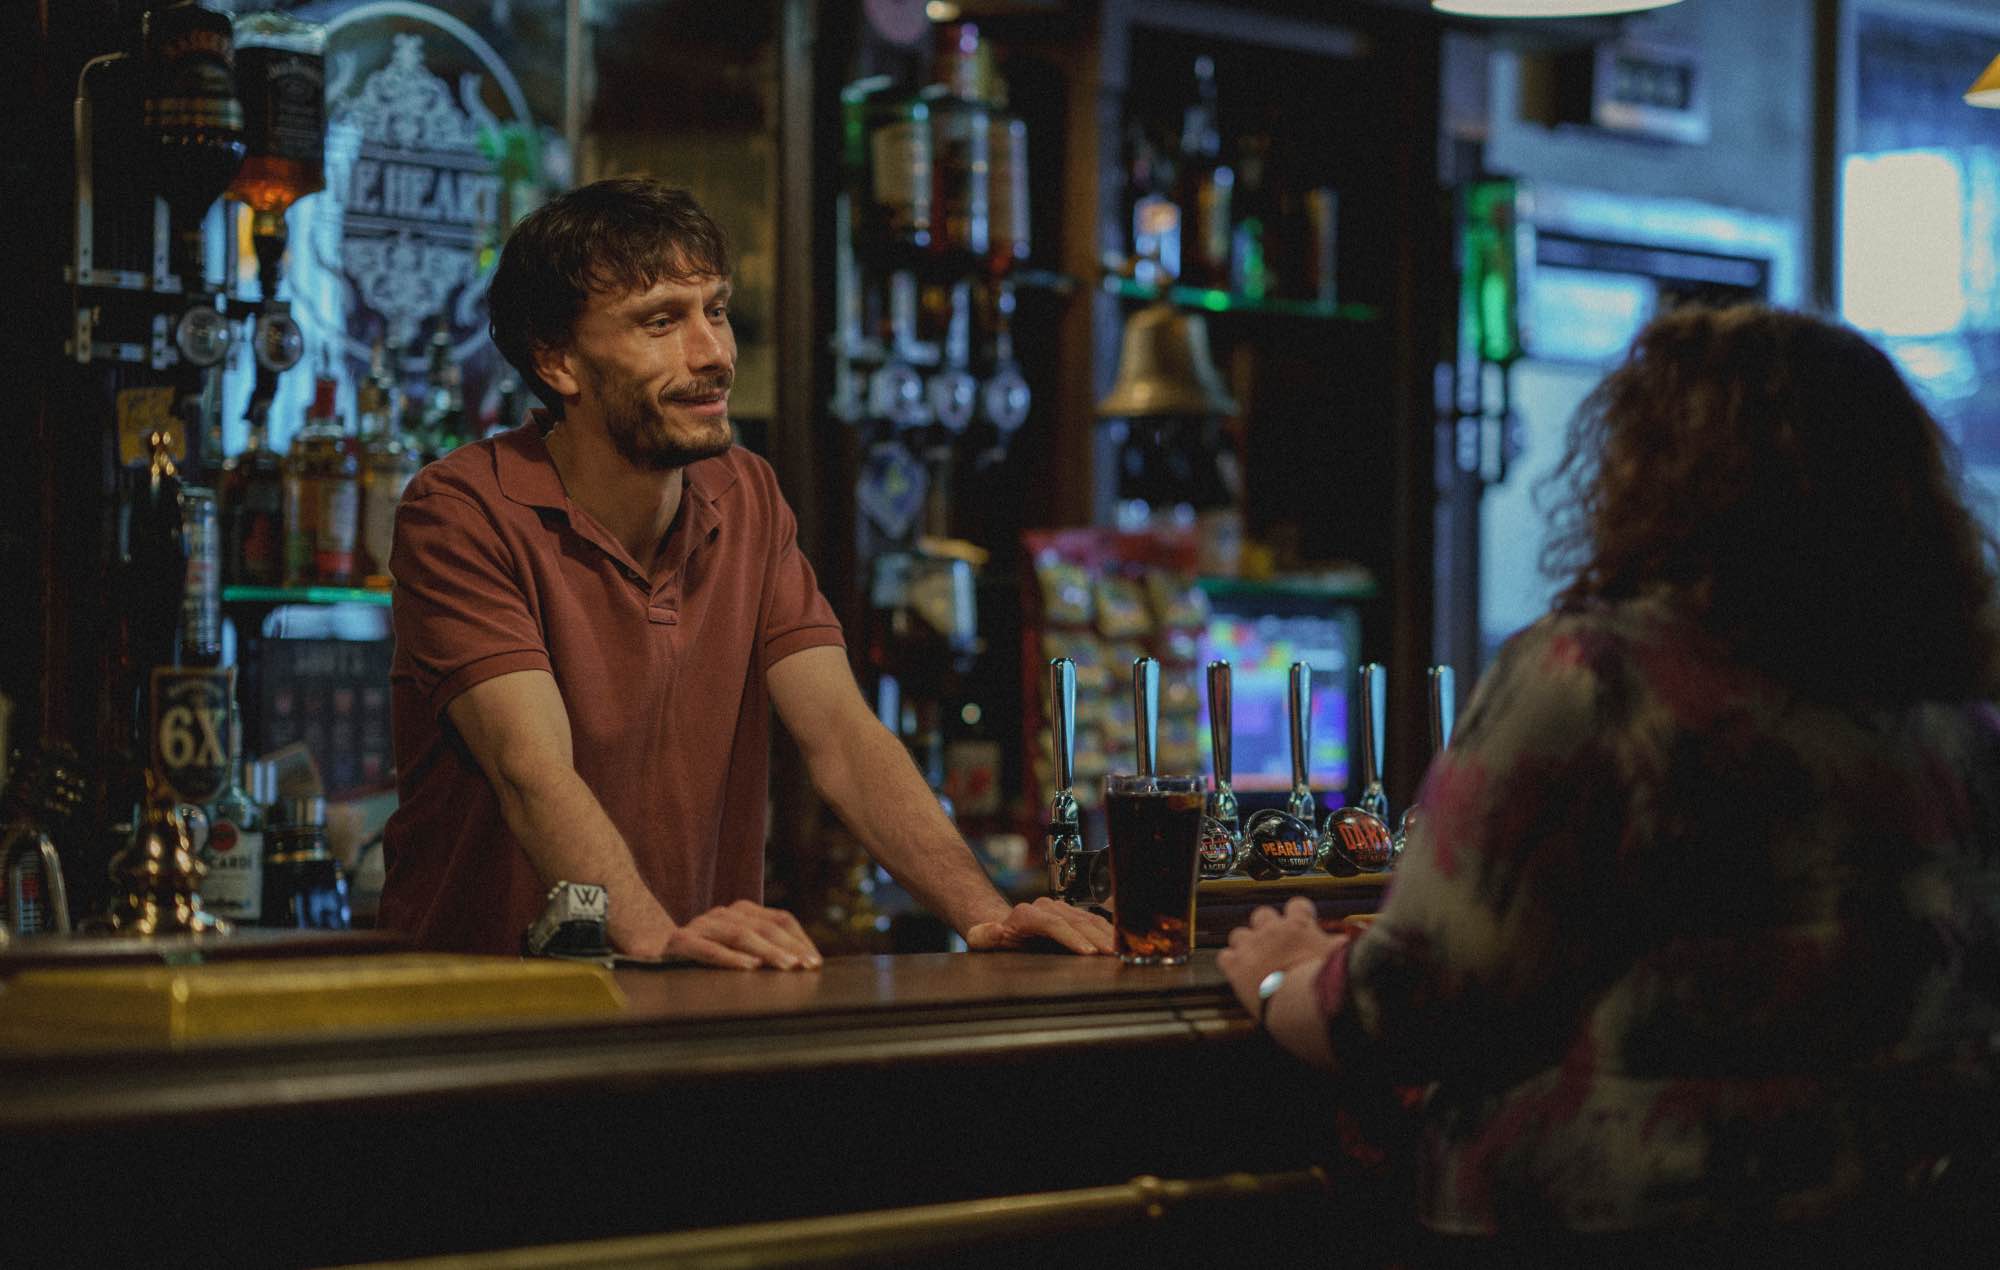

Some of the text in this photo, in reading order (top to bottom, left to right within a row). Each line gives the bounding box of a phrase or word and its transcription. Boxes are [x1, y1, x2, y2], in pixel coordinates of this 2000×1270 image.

[384, 163, 504, 224] HEART
[160, 704, 226, 768] 6X
[1262, 840, 1301, 857] PEARL
[574, 886, 600, 906] W
